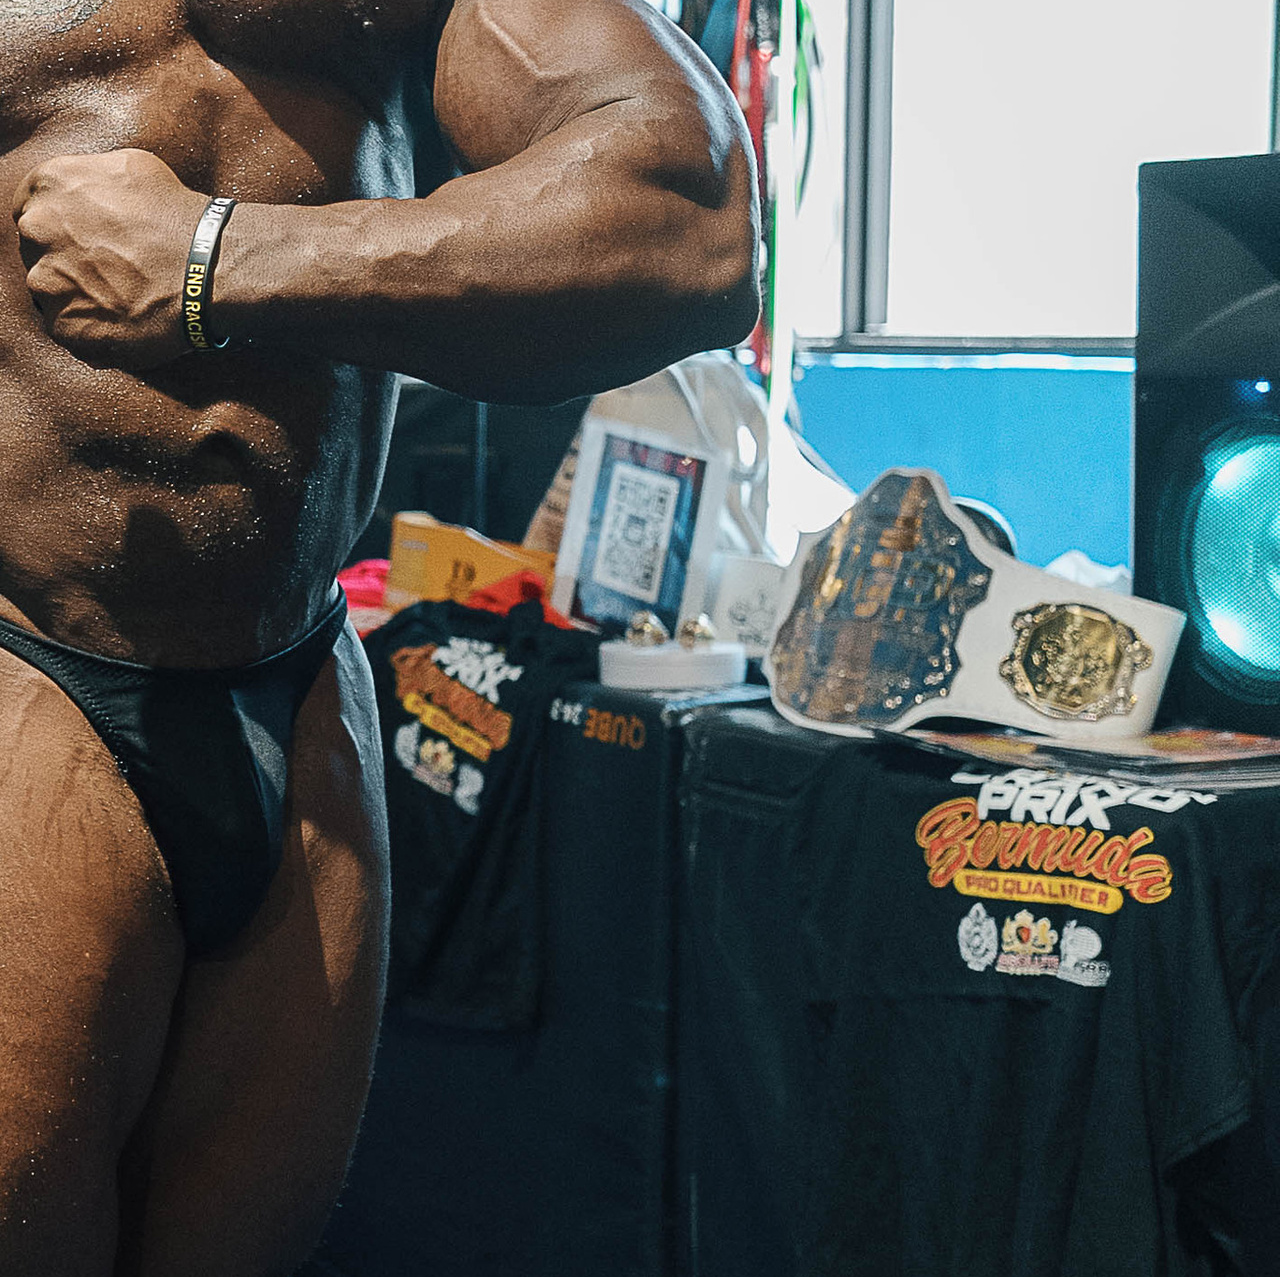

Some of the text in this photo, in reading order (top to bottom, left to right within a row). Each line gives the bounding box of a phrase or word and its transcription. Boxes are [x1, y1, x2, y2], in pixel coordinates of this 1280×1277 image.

[186, 263, 206, 298] END
[977, 779, 1118, 831] PRIX
[916, 796, 1173, 904] Bermuda
[964, 874, 1000, 893] PRO
